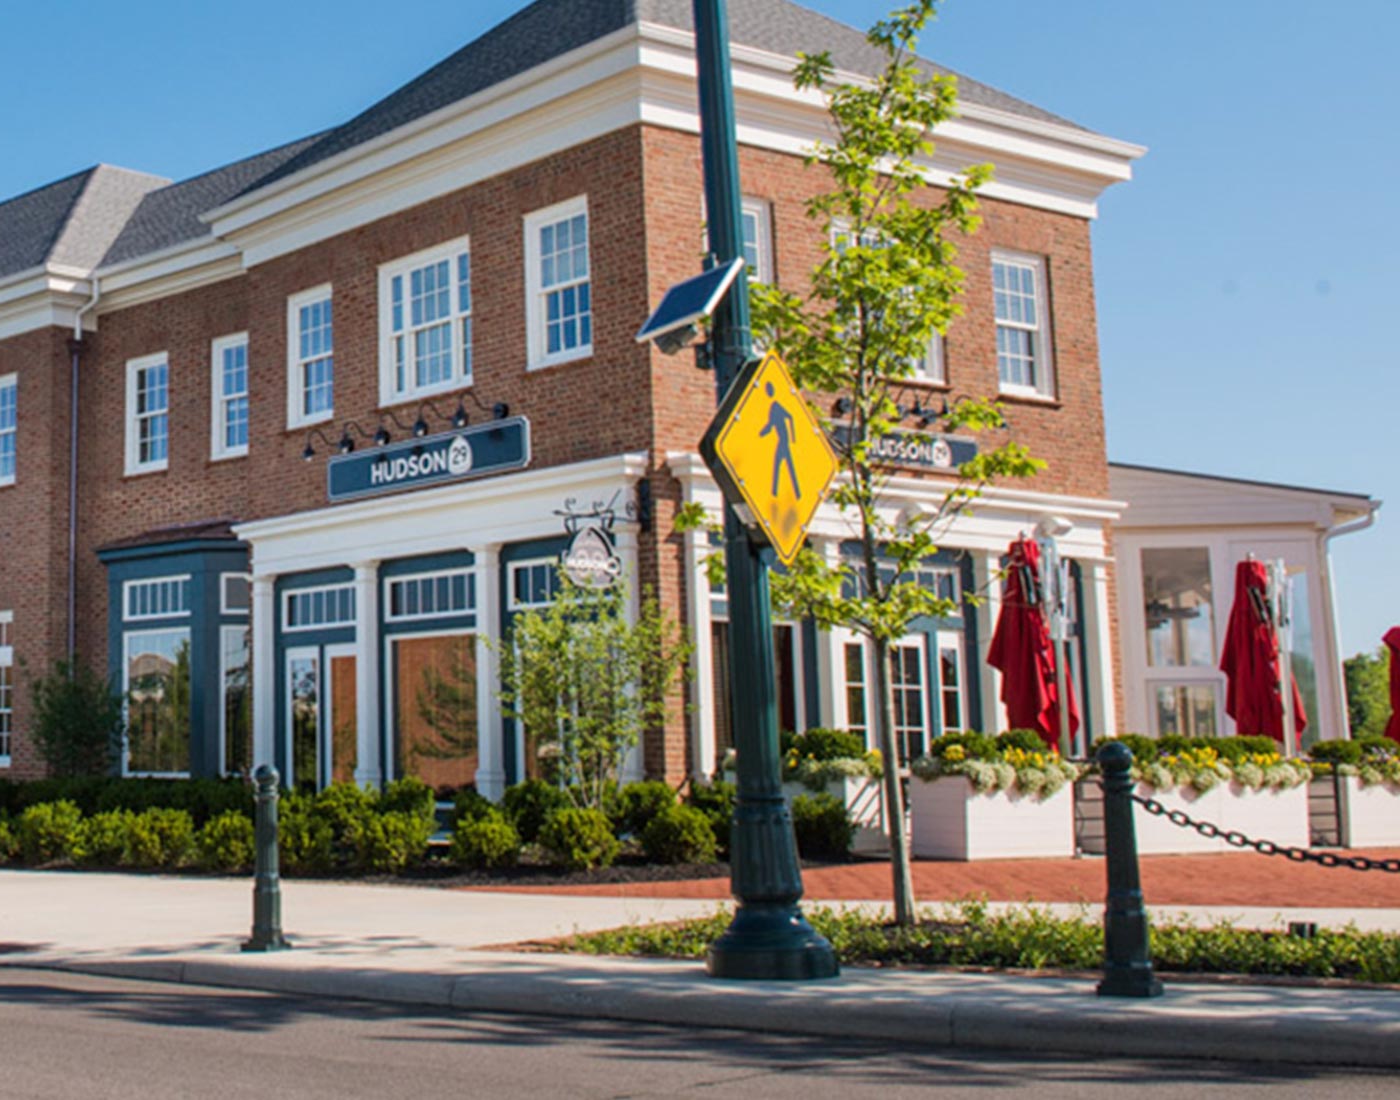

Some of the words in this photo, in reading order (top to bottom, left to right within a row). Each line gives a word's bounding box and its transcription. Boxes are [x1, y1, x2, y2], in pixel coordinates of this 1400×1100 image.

[371, 449, 447, 485] HUDSON
[452, 445, 468, 466] 29
[864, 437, 933, 462] HUDSON
